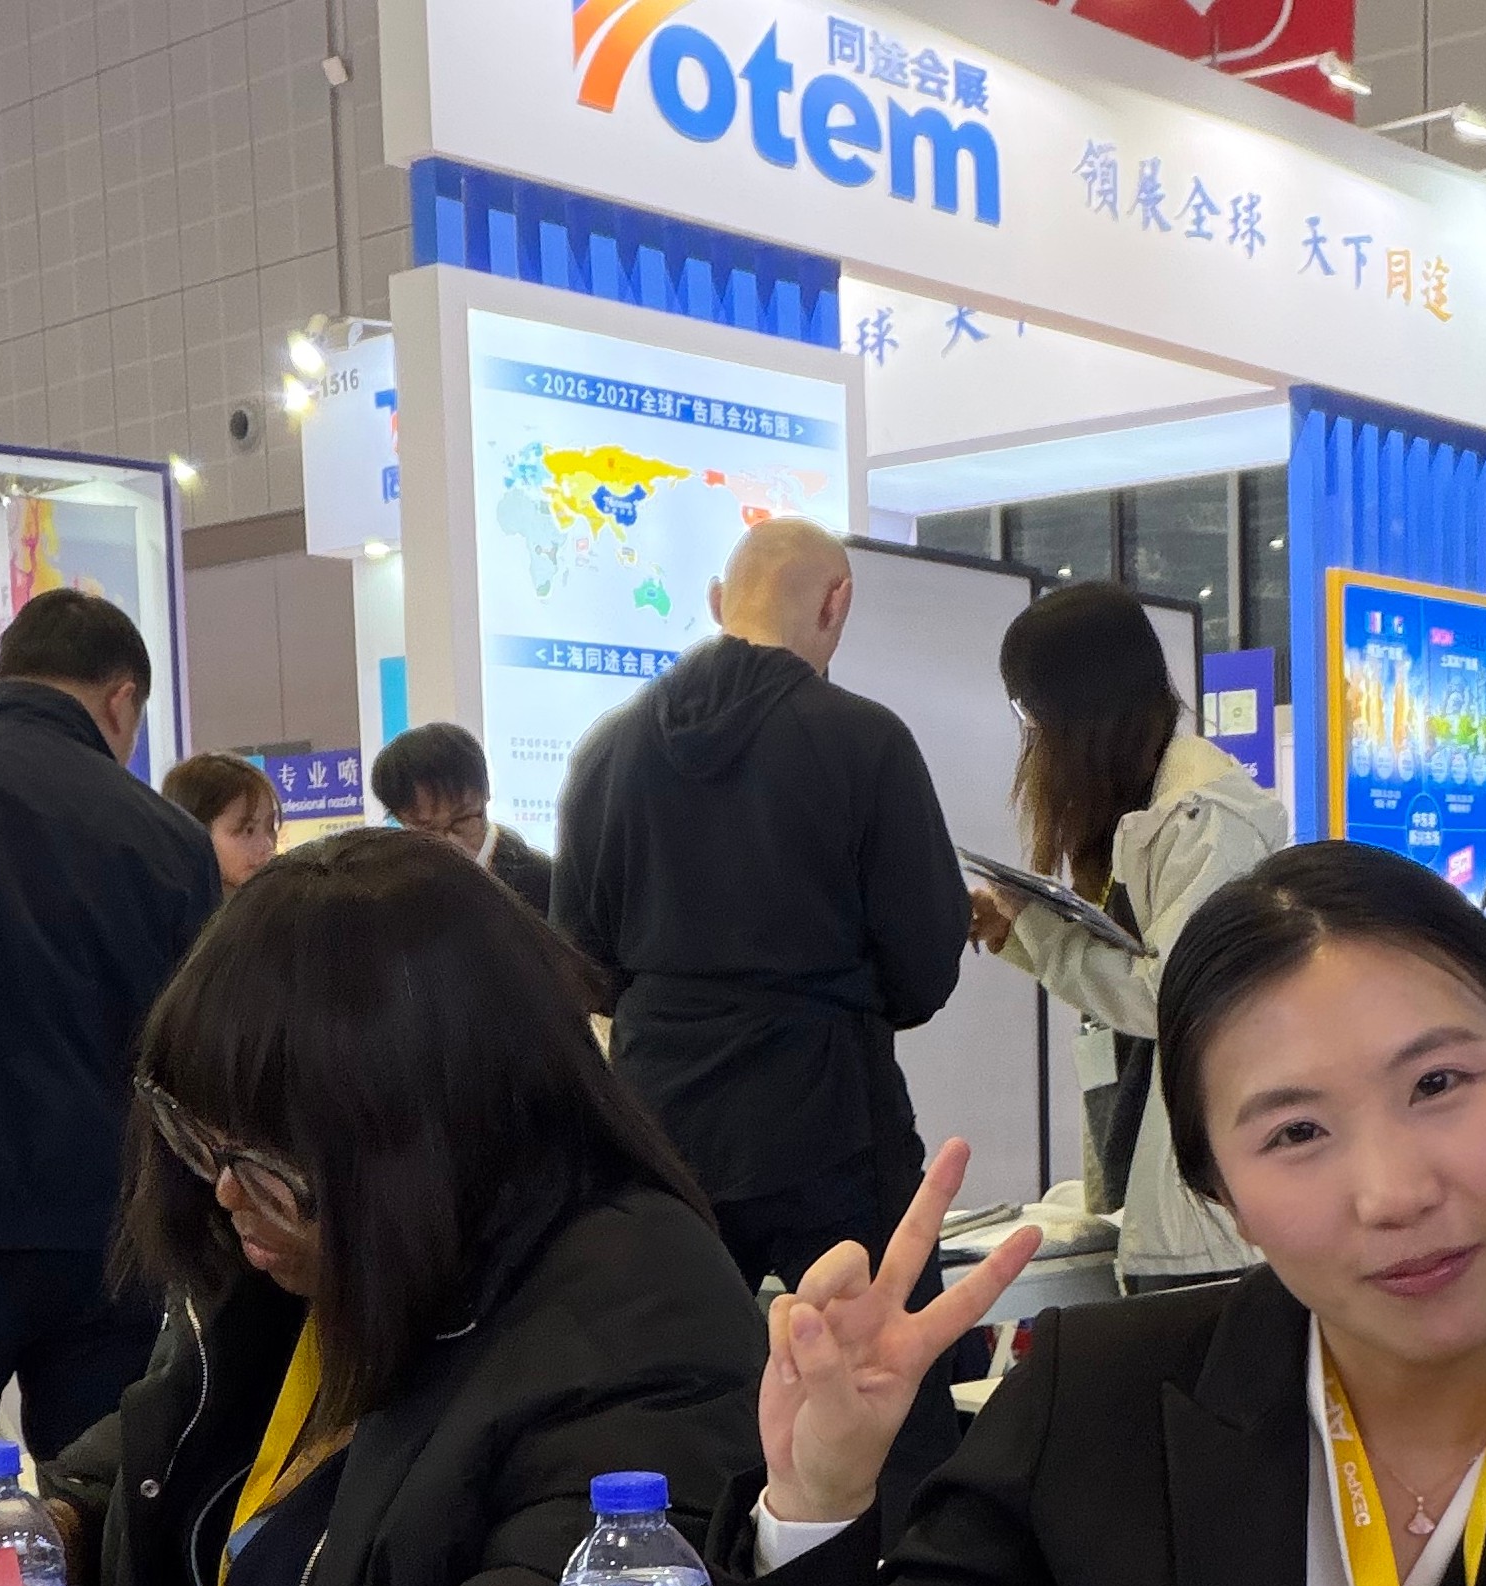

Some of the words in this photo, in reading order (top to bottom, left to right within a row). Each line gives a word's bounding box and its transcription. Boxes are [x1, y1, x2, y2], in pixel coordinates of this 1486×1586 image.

[827, 15, 990, 114] 同途会展
[313, 368, 359, 398] 1516
